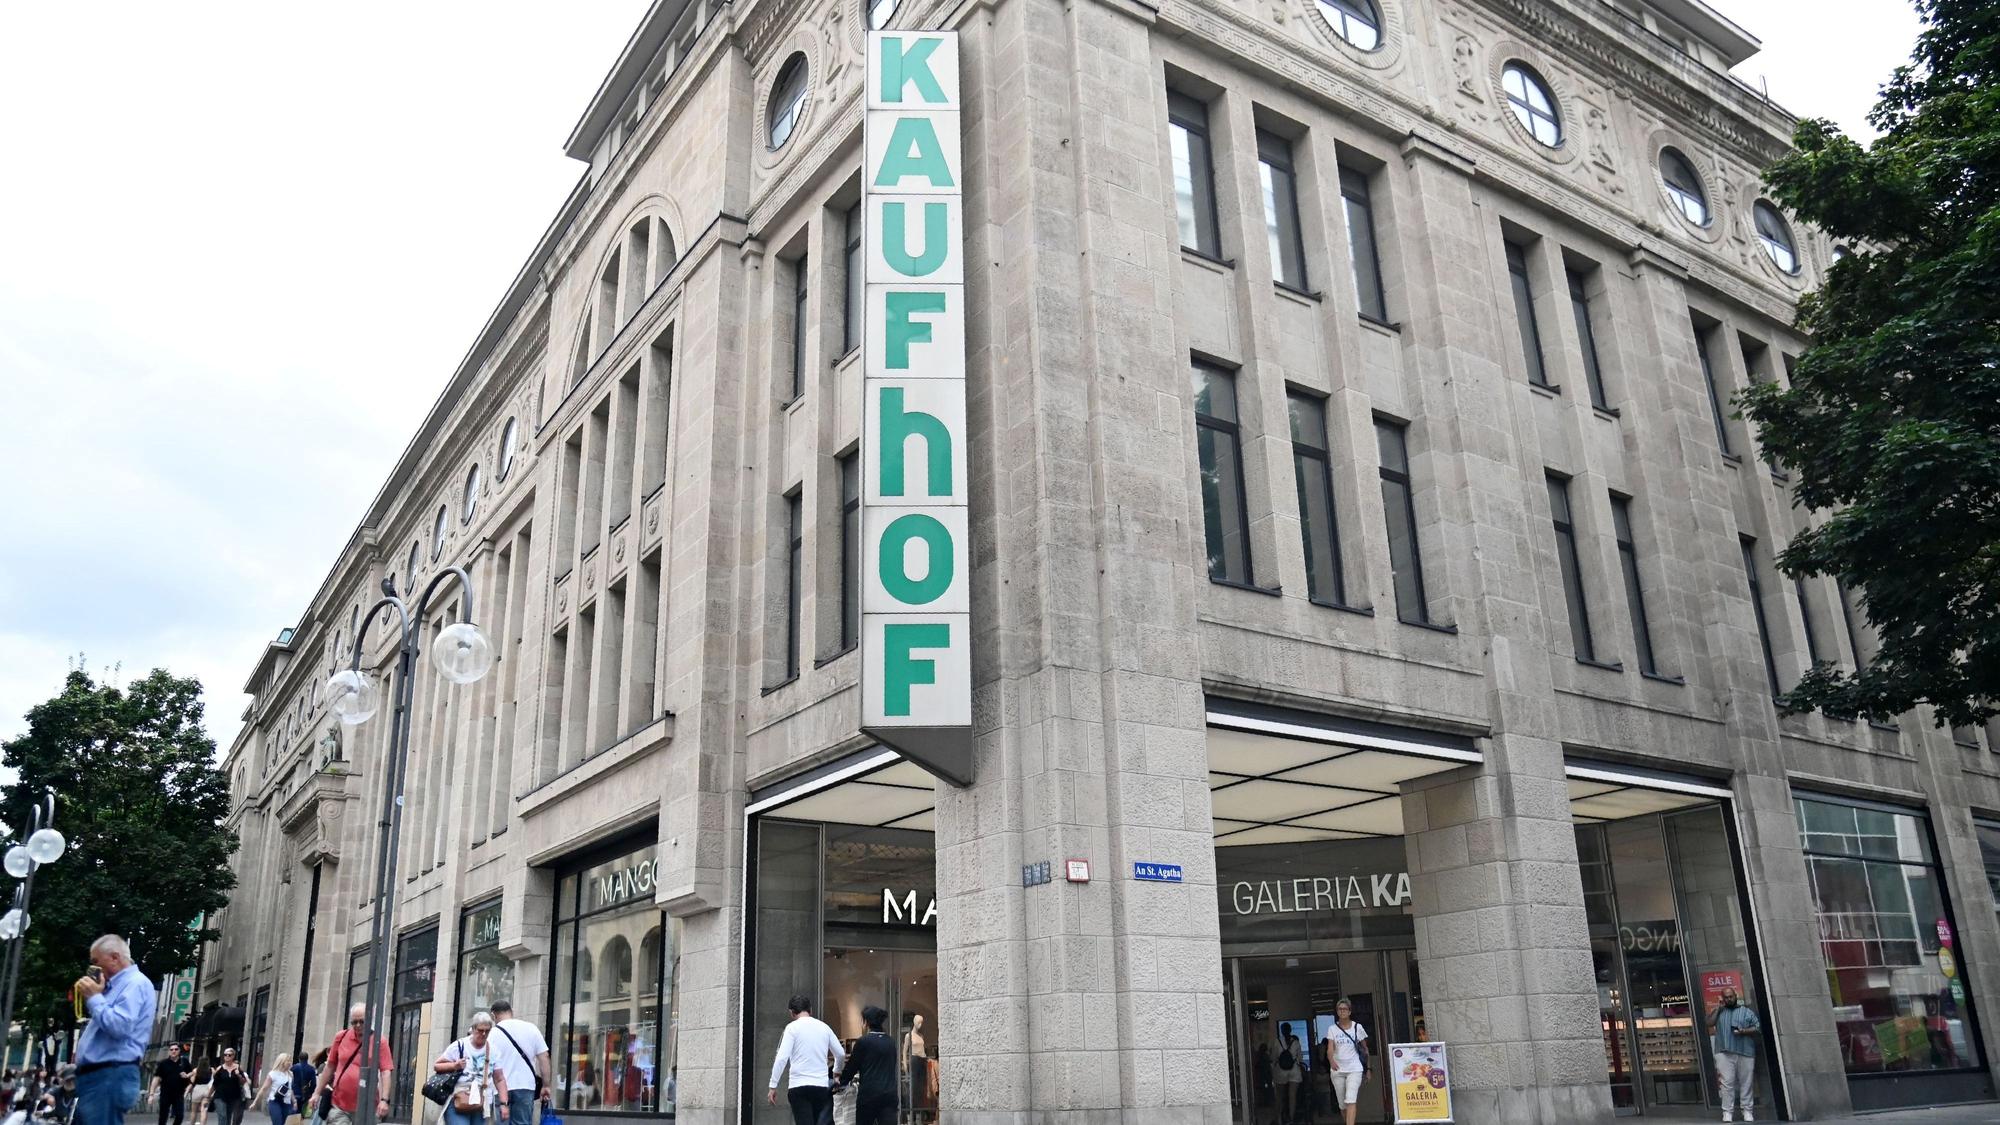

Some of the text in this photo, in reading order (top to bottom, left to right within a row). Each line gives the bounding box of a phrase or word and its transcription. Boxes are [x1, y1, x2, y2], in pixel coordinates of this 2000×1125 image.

[1135, 865, 1181, 880] An St. Agatha
[1233, 872, 1412, 915] GALERIA KA
[1707, 975, 1733, 986] SALE
[1405, 1091, 1438, 1101] GALERIA
